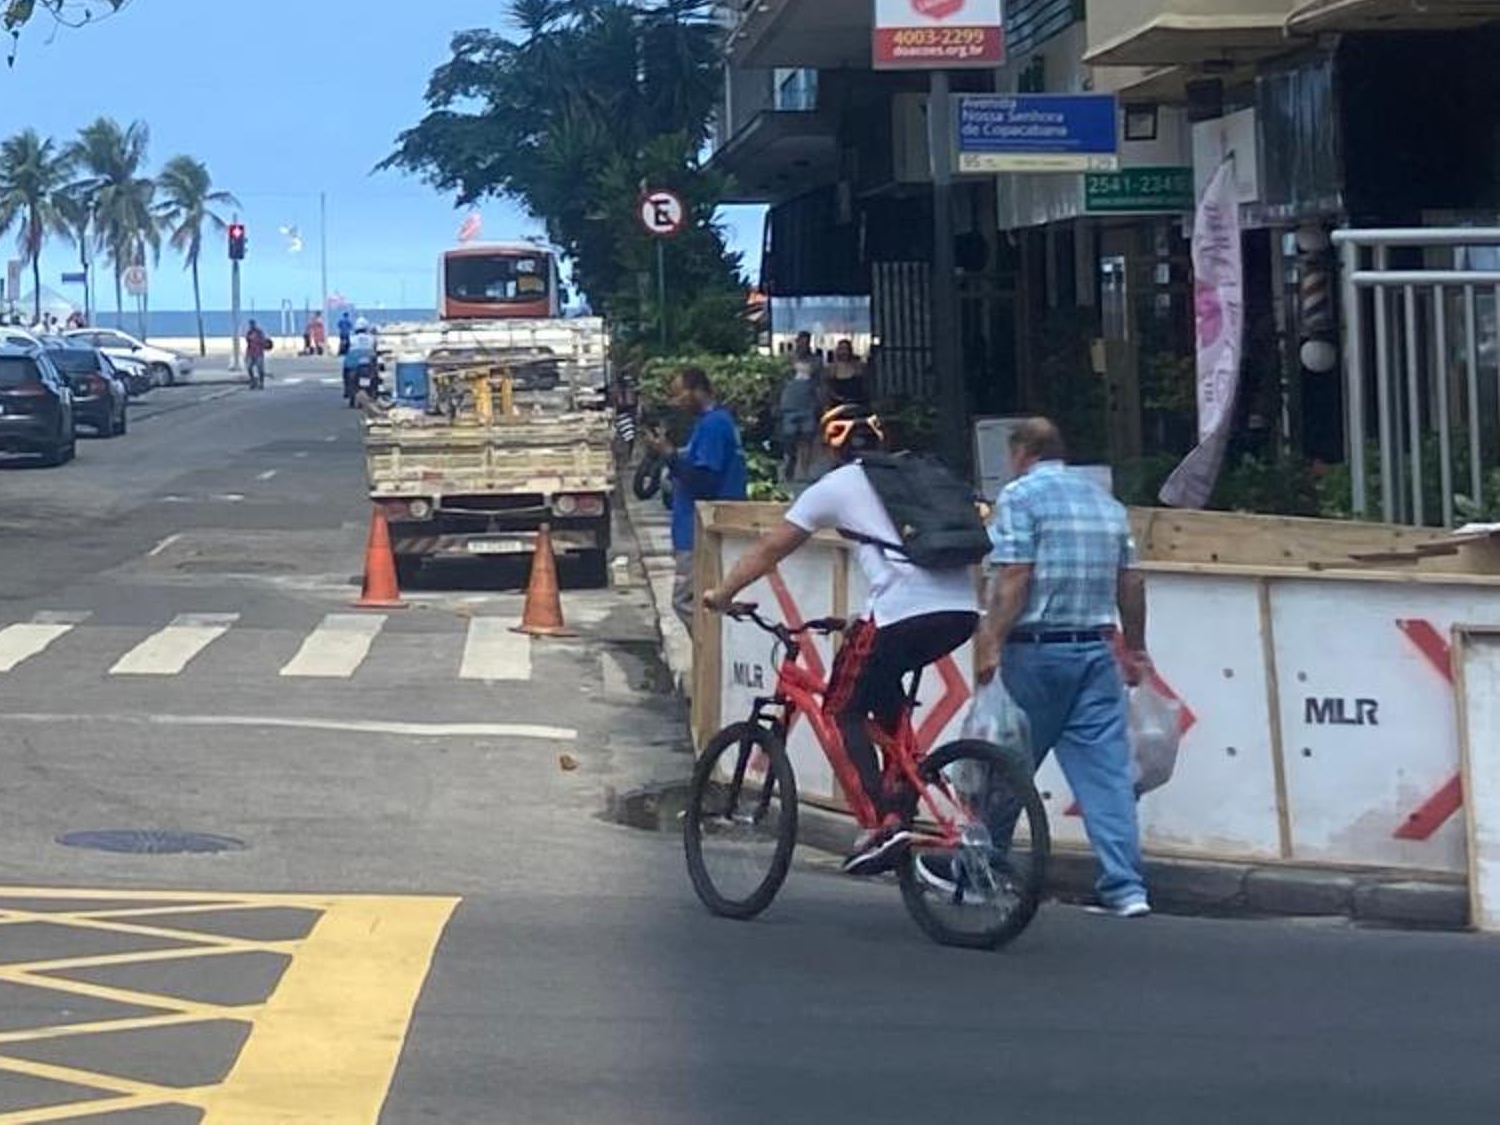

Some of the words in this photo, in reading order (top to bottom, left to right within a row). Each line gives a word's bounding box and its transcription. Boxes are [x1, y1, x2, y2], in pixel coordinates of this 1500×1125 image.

[893, 29, 985, 44] 4003-2299
[962, 109, 1004, 121] Nossa
[1008, 109, 1064, 122] Senhora
[962, 124, 980, 136] de
[983, 124, 1068, 138] Copacabana
[653, 199, 671, 226] E
[733, 661, 764, 689] MLR
[1305, 697, 1379, 725] MLR
